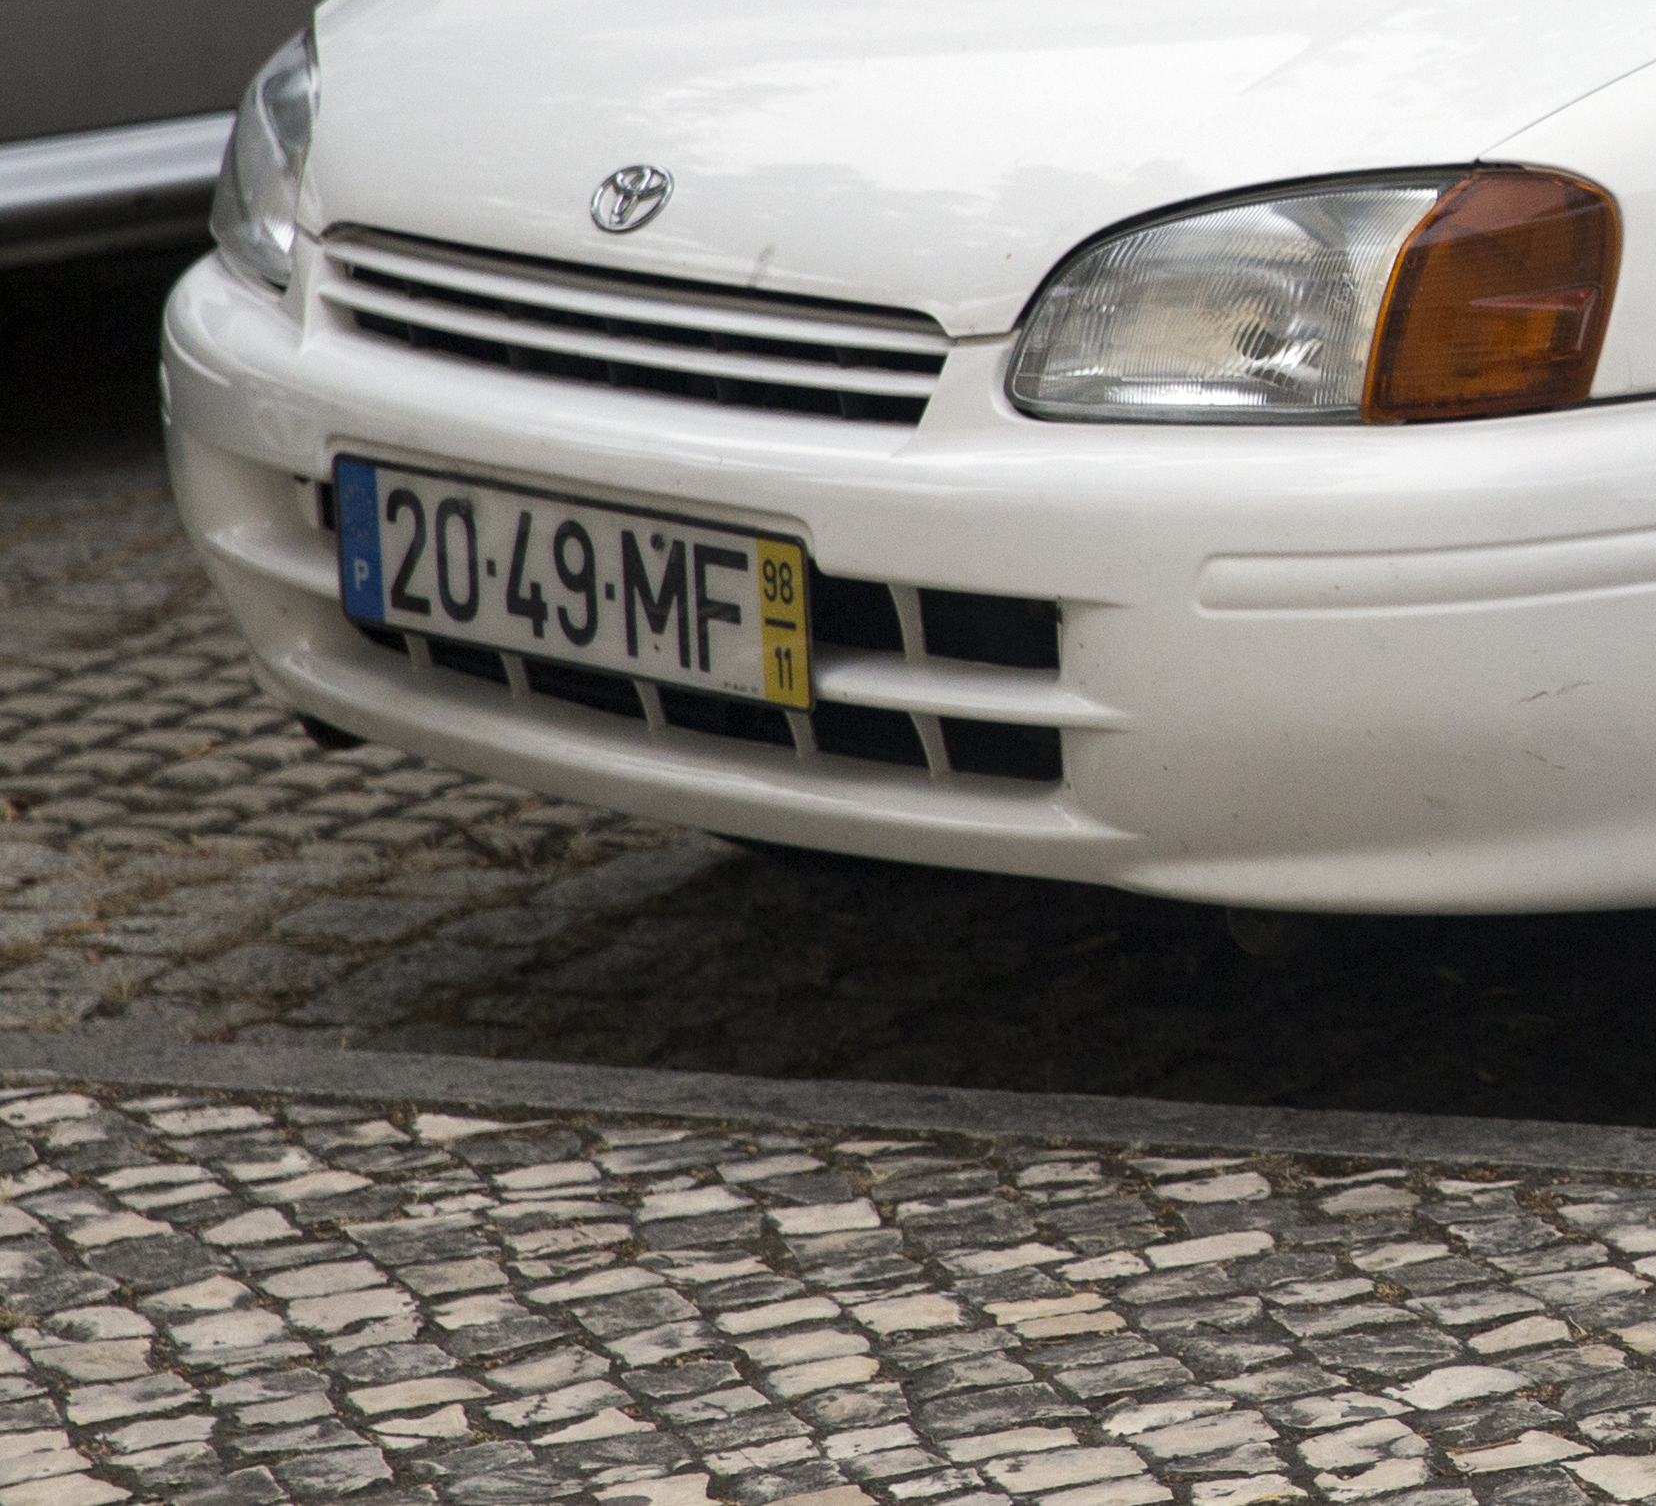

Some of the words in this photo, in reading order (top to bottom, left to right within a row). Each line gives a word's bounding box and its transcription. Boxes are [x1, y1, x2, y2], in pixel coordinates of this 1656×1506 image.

[353, 557, 370, 592] P
[761, 558, 794, 606] 98
[774, 646, 794, 692] 11
